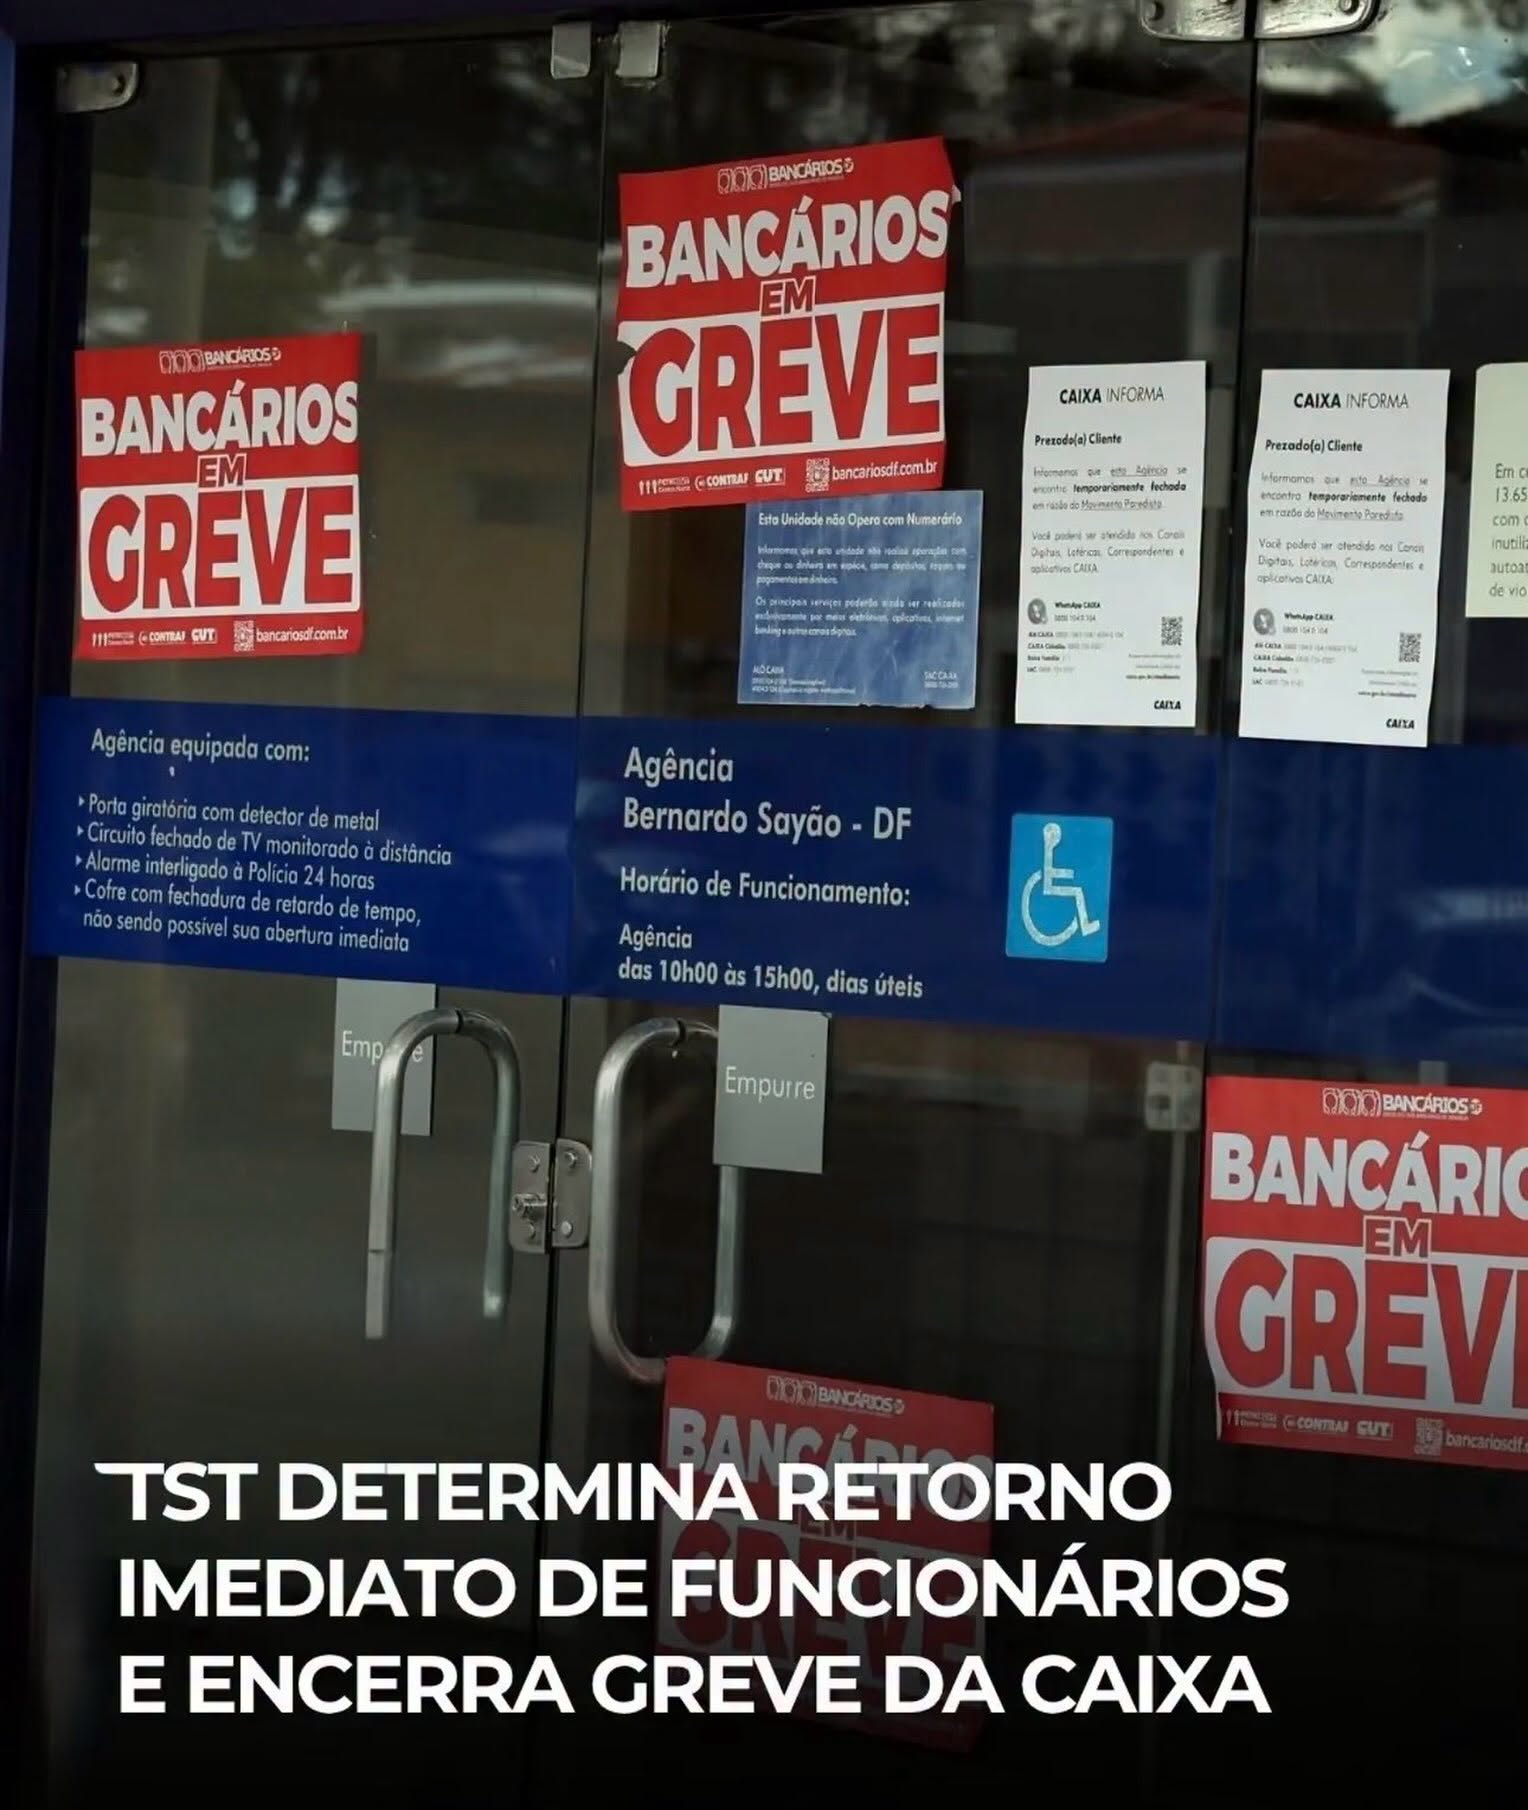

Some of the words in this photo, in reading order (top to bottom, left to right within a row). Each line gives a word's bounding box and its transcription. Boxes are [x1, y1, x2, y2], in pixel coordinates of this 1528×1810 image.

[769, 158, 842, 181] BANCÁRIOS
[626, 190, 949, 288] BANCÁRIOS
[761, 276, 815, 317] EM
[204, 347, 272, 365] BANCÁRIOS
[630, 304, 939, 457] GREVE
[1060, 389, 1101, 404] CAIXA
[1106, 387, 1164, 402] INFORMA
[1294, 393, 1341, 409] CAIXA
[1345, 393, 1408, 409] INFORMA
[81, 379, 357, 456] BANCÁRIOS
[1035, 433, 1086, 447] Prezado(a)
[1089, 433, 1122, 445] Cliente
[1265, 440, 1325, 454] Prezado(a)
[1327, 440, 1362, 452] Cliente
[198, 453, 247, 488] EM
[832, 462, 937, 480] bancariosdf.com.br
[1088, 469, 1100, 477] que
[1324, 477, 1339, 485] que
[1496, 463, 1514, 478] Em
[1519, 468, 1528, 478] c
[1073, 482, 1144, 493] temporariamente
[1151, 481, 1186, 491] fechada
[1309, 491, 1386, 503] temporariamente
[1393, 492, 1427, 502] fechada
[759, 512, 779, 526] Esta
[781, 511, 823, 526] Unidade
[826, 513, 845, 526] não
[848, 512, 880, 529] Opera
[883, 515, 904, 526] com
[907, 511, 962, 526] Numerário
[1492, 515, 1519, 526] com
[89, 485, 353, 613] GREVE
[1489, 582, 1504, 596] de
[256, 626, 348, 643] bancariosdf.com.br
[1154, 700, 1181, 710] CAIXA
[1386, 719, 1415, 729] CAIXA
[91, 728, 164, 757] Agência
[171, 734, 258, 763] equipada
[265, 740, 310, 762] com:
[624, 746, 733, 787] Agência
[89, 794, 126, 816] Porta
[132, 798, 196, 823] giratória
[202, 805, 234, 821] com
[240, 802, 303, 827] detector
[309, 807, 328, 828] de
[334, 809, 380, 831] metal
[624, 797, 747, 833] Bernardo
[758, 801, 841, 844] Sayão
[853, 823, 862, 831] -
[873, 806, 911, 840] DF
[87, 823, 145, 845] Circuito
[151, 826, 211, 849] fechado
[217, 830, 236, 850] de
[241, 832, 261, 852] TV
[266, 834, 358, 859] monitorado
[364, 840, 373, 860] à
[380, 839, 451, 865] distância
[85, 852, 140, 873] Alarme
[146, 854, 228, 883] interligado
[234, 860, 242, 881] à
[248, 861, 298, 884] Polícia
[304, 865, 323, 886] 24
[331, 867, 374, 890] horas
[620, 866, 698, 895] Horário
[706, 870, 730, 896] de
[739, 872, 910, 906] Funcionamento:
[85, 878, 126, 901] Cofre
[131, 886, 162, 903] com
[168, 883, 246, 909] fechadura
[251, 890, 270, 911] de
[276, 893, 333, 917] retardo
[339, 896, 359, 918] de
[365, 899, 421, 927] tempo,
[83, 910, 112, 929] não
[117, 911, 162, 933] sendo
[168, 916, 228, 938] possível
[233, 923, 259, 940] sua
[265, 923, 333, 946] abertura
[339, 929, 409, 952] imediata
[620, 923, 692, 951] Agência
[618, 956, 652, 980] das
[659, 959, 717, 984] 10h00
[724, 962, 746, 986] às
[754, 965, 820, 995] 15h00,
[826, 969, 868, 994] dias
[875, 972, 923, 998] úteis
[342, 1030, 423, 1065] Empe
[725, 1066, 815, 1102] Empurre
[1382, 1093, 1469, 1114] BANCÁRIOS
[1364, 1216, 1431, 1258] EM
[1215, 1248, 1528, 1408] GREV
[819, 1386, 892, 1412] BANCÁRIOS
